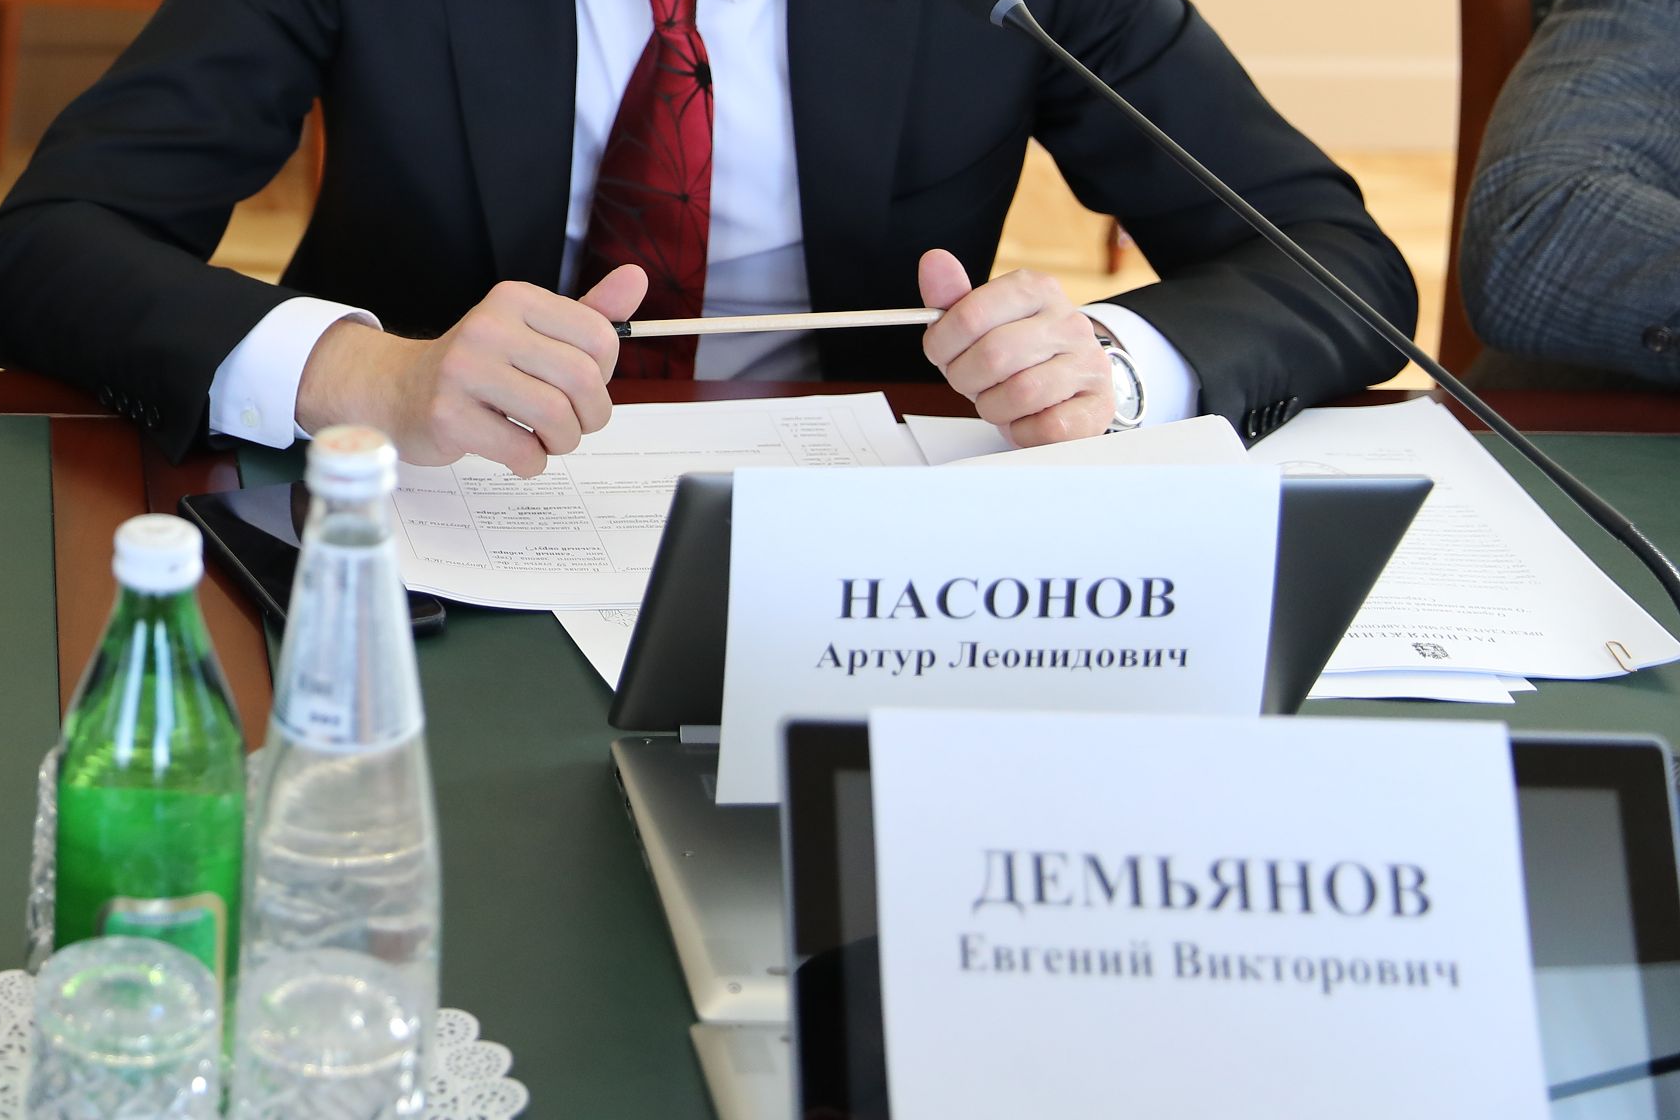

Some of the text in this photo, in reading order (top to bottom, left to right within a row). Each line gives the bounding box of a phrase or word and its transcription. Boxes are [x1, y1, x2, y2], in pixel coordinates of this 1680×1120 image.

[839, 576, 1177, 621] НАСОНОВ
[816, 641, 1188, 678] Артур Леонидович
[1340, 632, 1496, 643] РАСПОРЯЖЕНИ
[972, 849, 1433, 920] ДЕМЬЯНОВ
[957, 931, 1461, 997] Евгений Викторович
